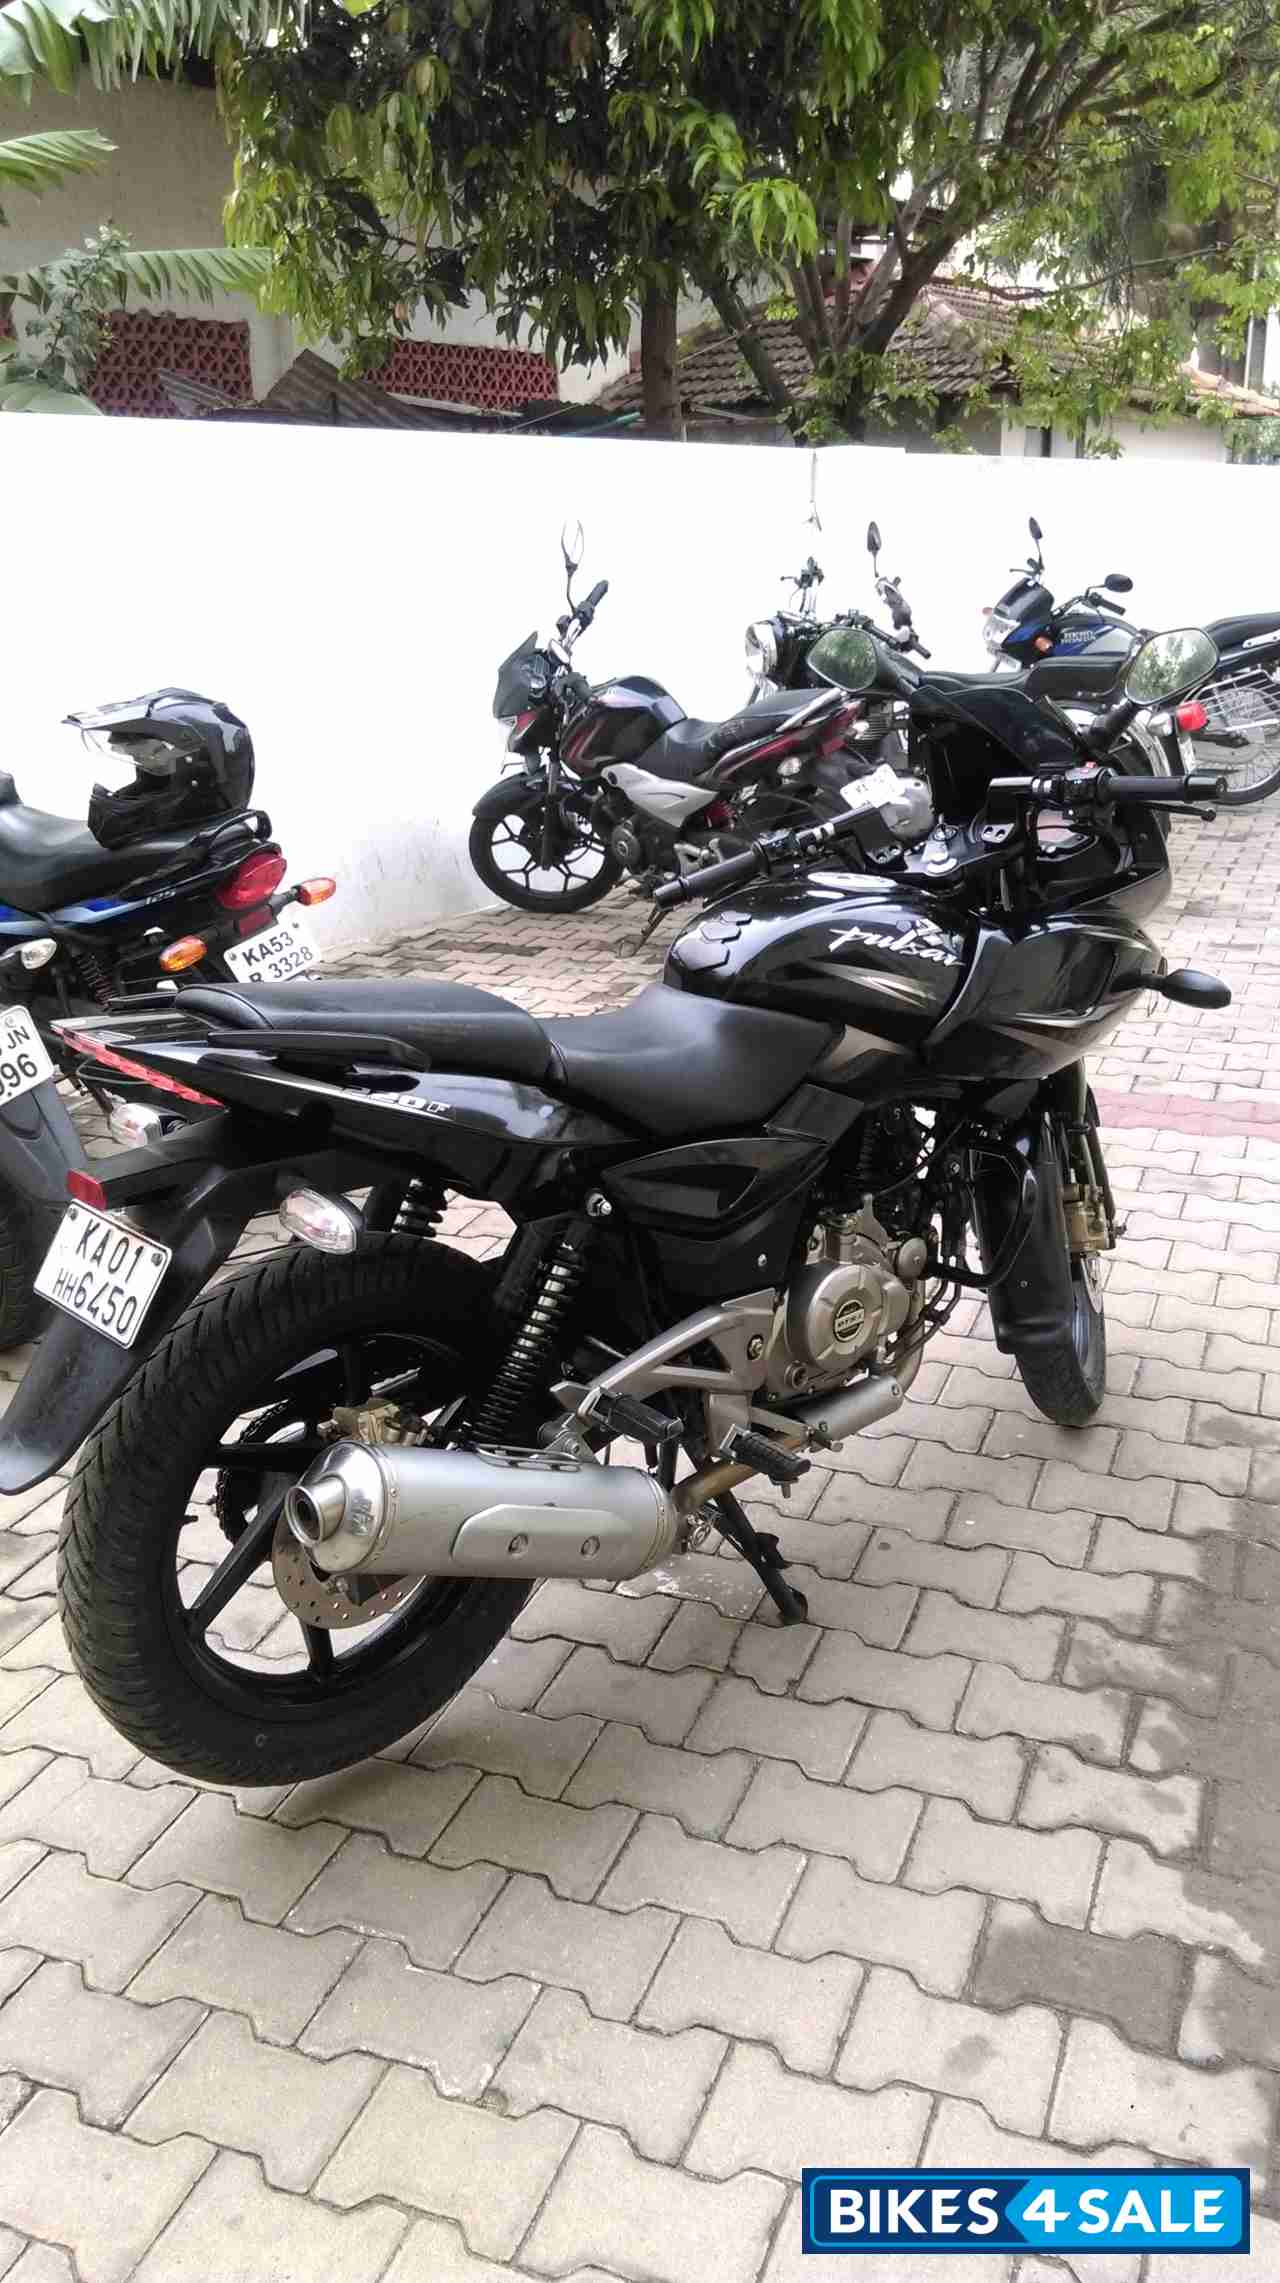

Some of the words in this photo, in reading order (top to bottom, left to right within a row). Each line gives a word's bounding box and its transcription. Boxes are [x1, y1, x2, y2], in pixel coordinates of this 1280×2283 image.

[242, 931, 294, 967] KA53
[268, 946, 313, 978] 3328
[7, 1025, 30, 1050] JN
[0, 1053, 38, 1097] 96
[75, 1218, 145, 1284] KA01
